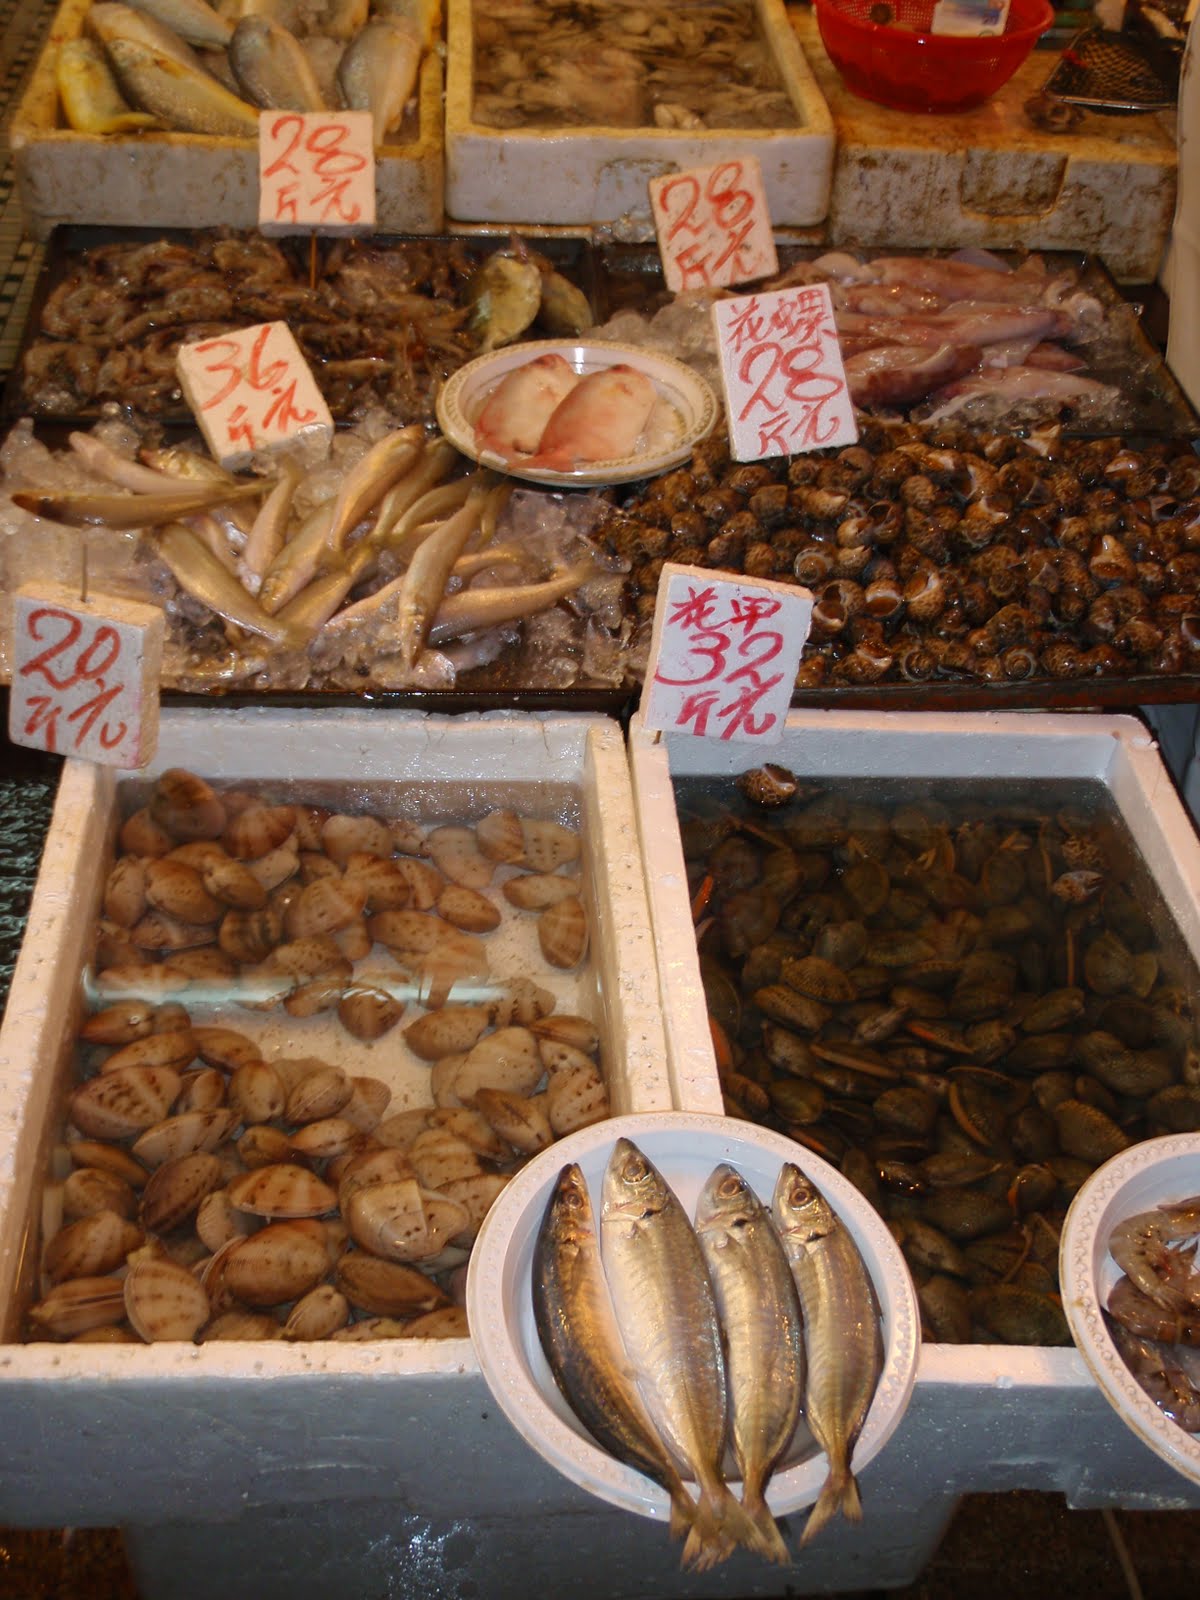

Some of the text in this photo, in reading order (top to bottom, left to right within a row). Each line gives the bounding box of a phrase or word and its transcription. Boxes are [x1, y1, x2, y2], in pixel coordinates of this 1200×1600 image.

[263, 115, 368, 177] 28
[659, 162, 755, 241] 28
[194, 325, 289, 411] 36
[738, 341, 844, 421] 28
[20, 608, 121, 691] 20
[667, 586, 782, 636] 花甲
[654, 631, 784, 688] 32
